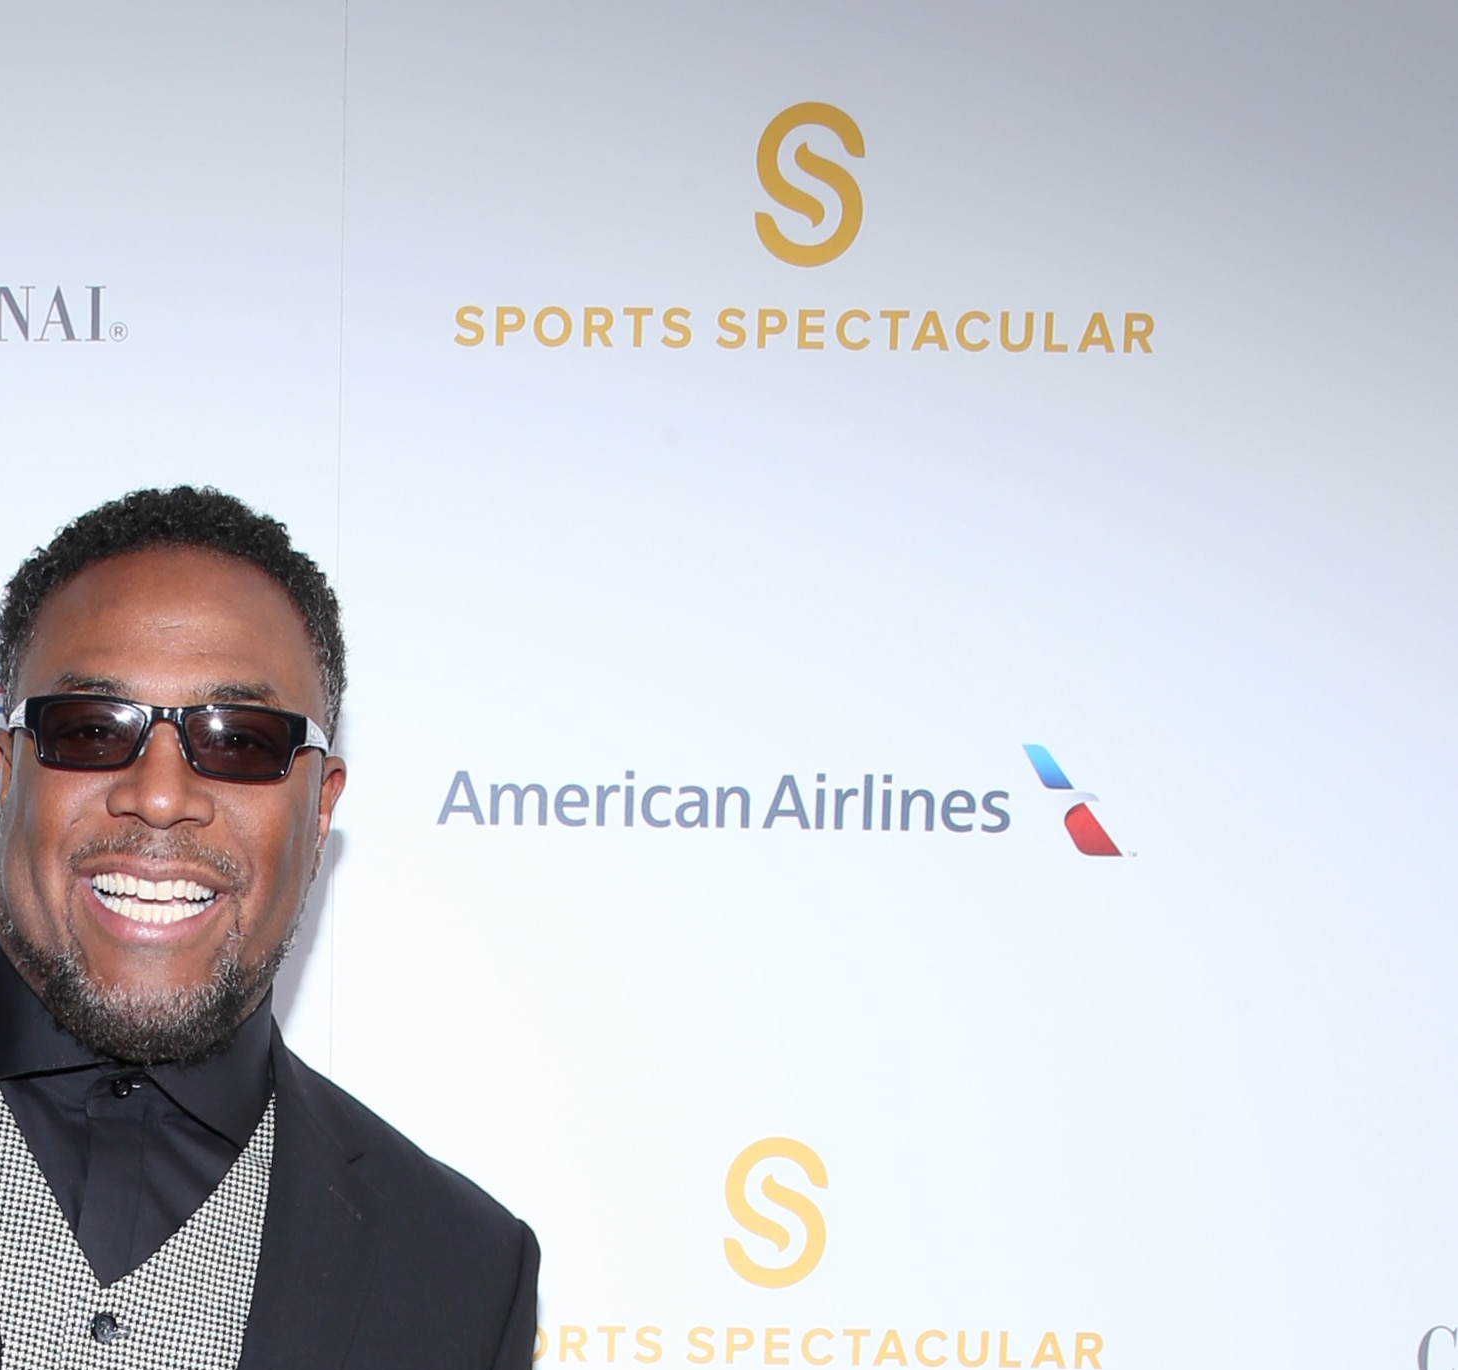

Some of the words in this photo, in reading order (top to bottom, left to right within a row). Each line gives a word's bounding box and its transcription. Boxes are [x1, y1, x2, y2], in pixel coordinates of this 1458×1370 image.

[454, 305, 692, 349] SPORTS
[716, 307, 1155, 354] SPECTACULAR
[436, 769, 751, 829] American
[762, 772, 1011, 834] Airlines
[687, 1326, 1104, 1370] SPECTACULAR
